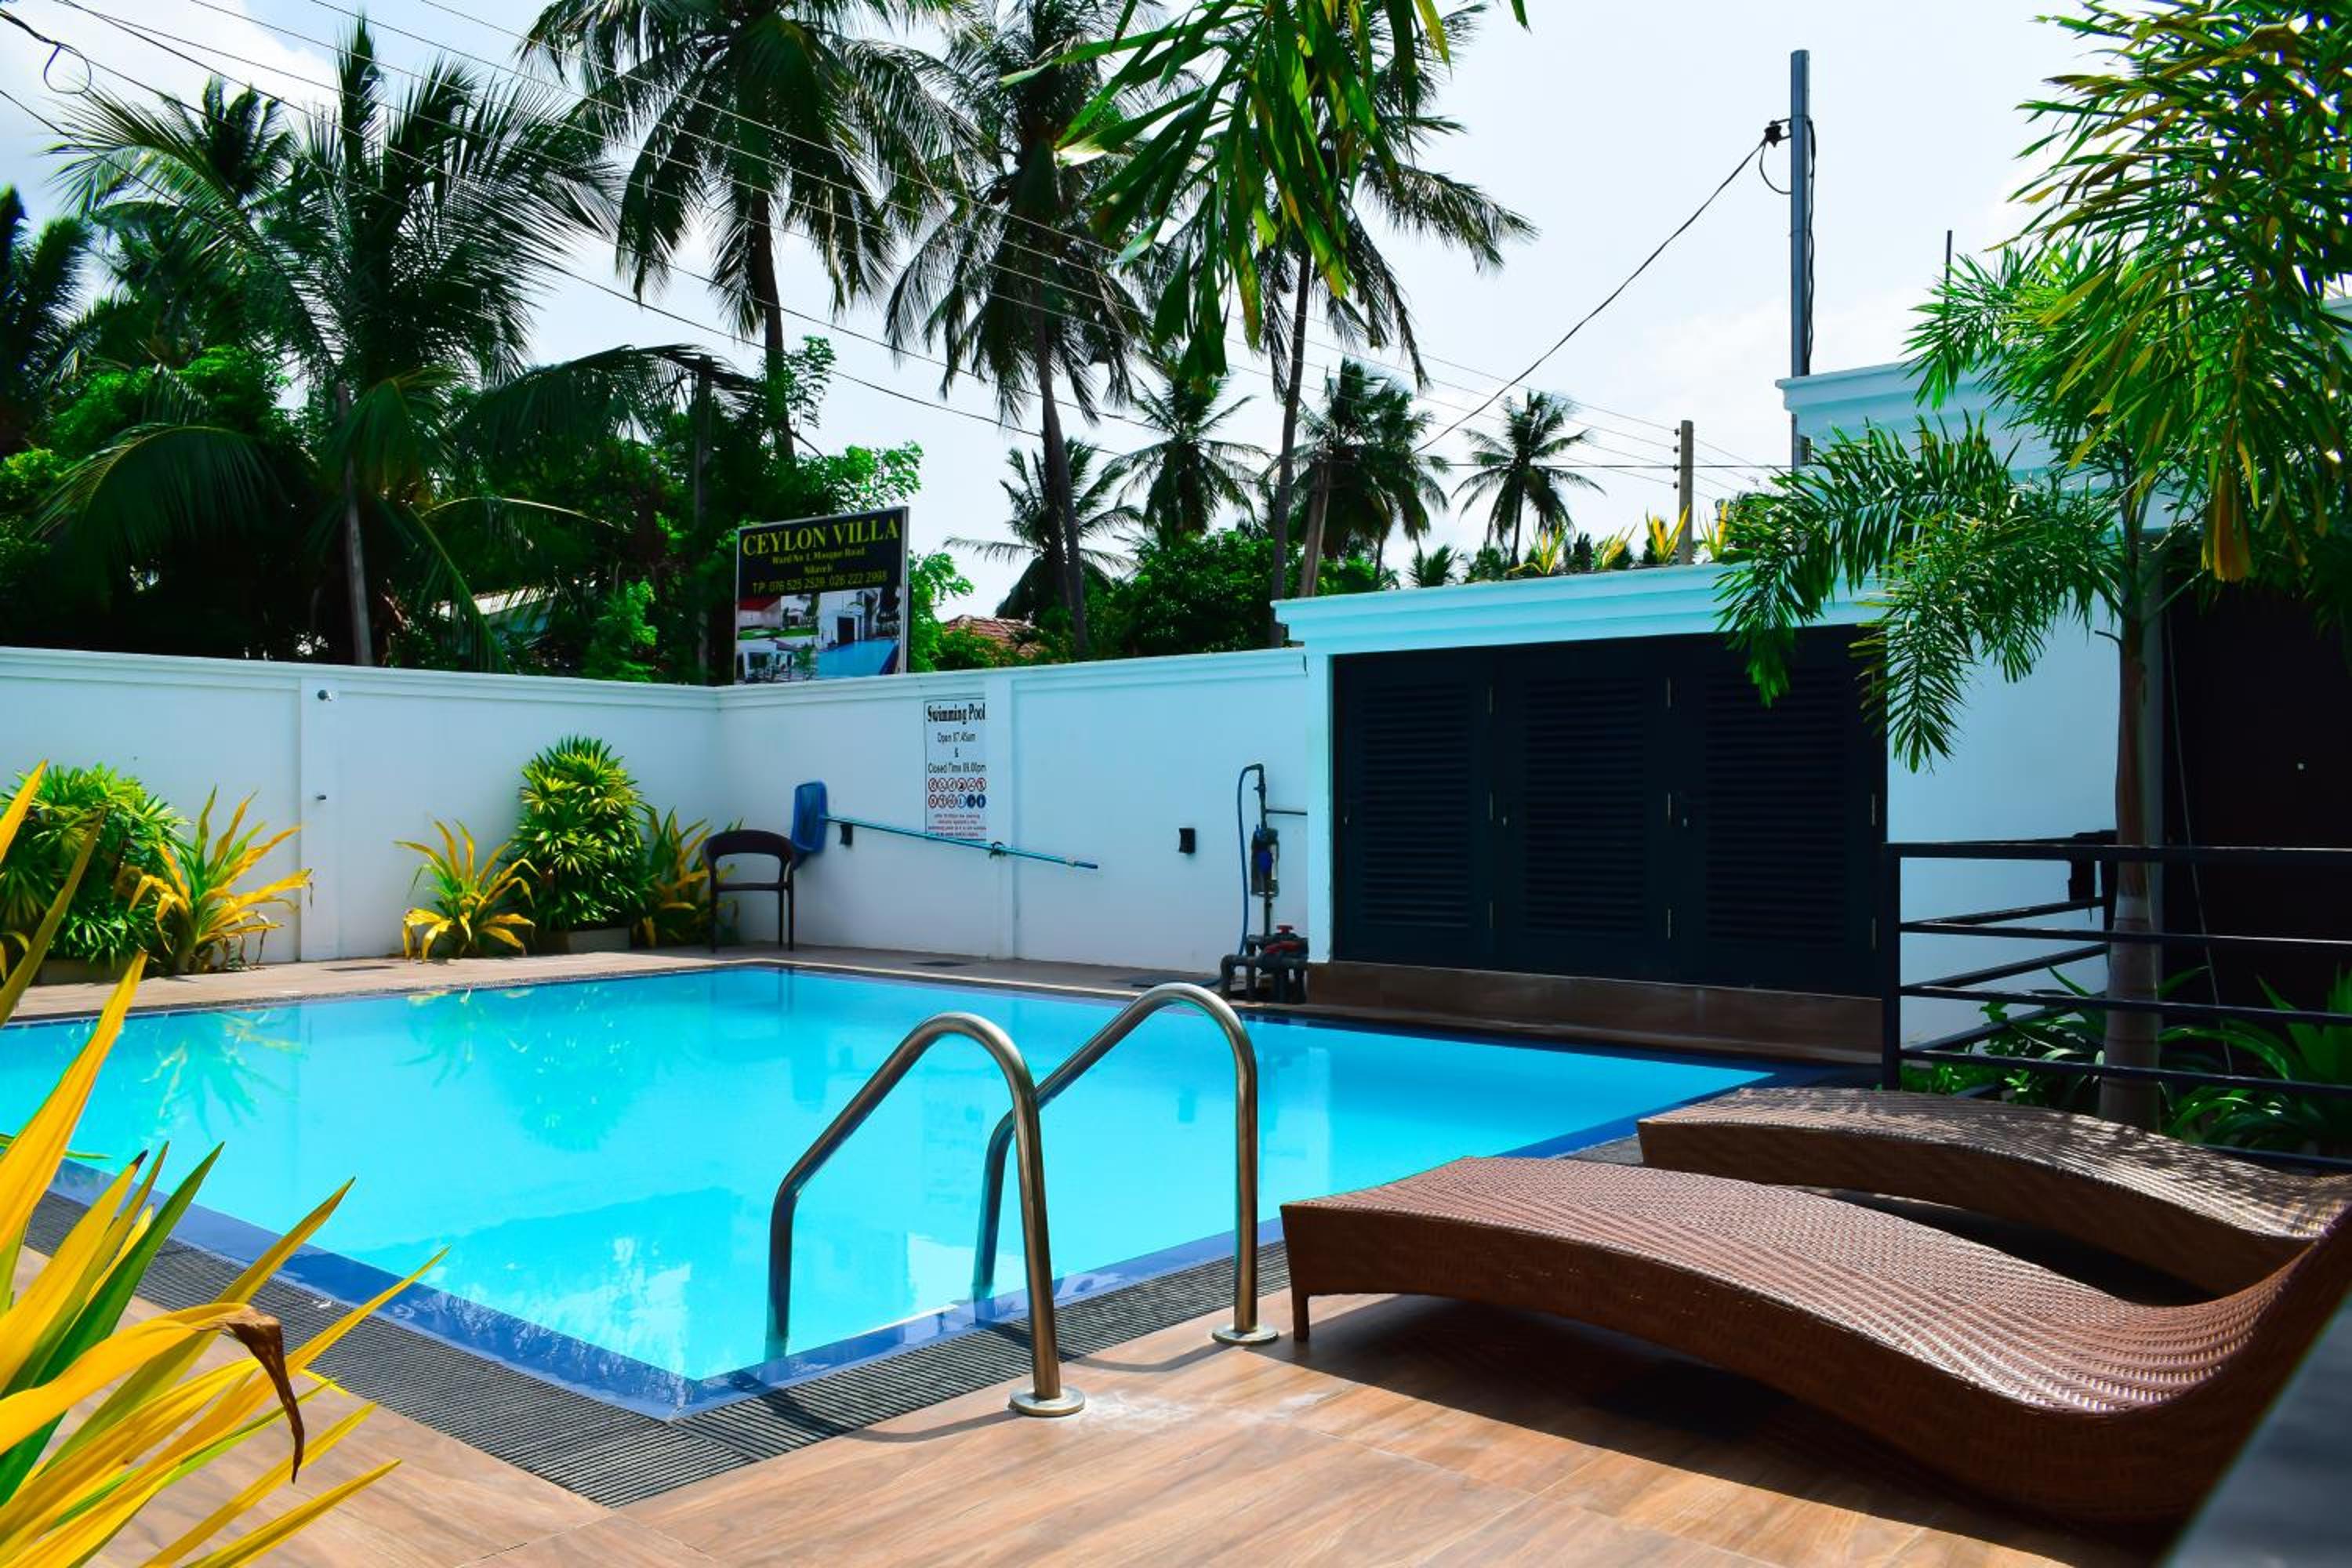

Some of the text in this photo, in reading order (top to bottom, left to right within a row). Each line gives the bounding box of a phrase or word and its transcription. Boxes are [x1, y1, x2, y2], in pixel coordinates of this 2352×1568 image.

[742, 517, 899, 556] CEYLON VILLA
[844, 546, 865, 557] Road
[927, 702, 985, 725] Swimming Pool
[937, 732, 952, 745] Open
[928, 762, 947, 774] Closed
